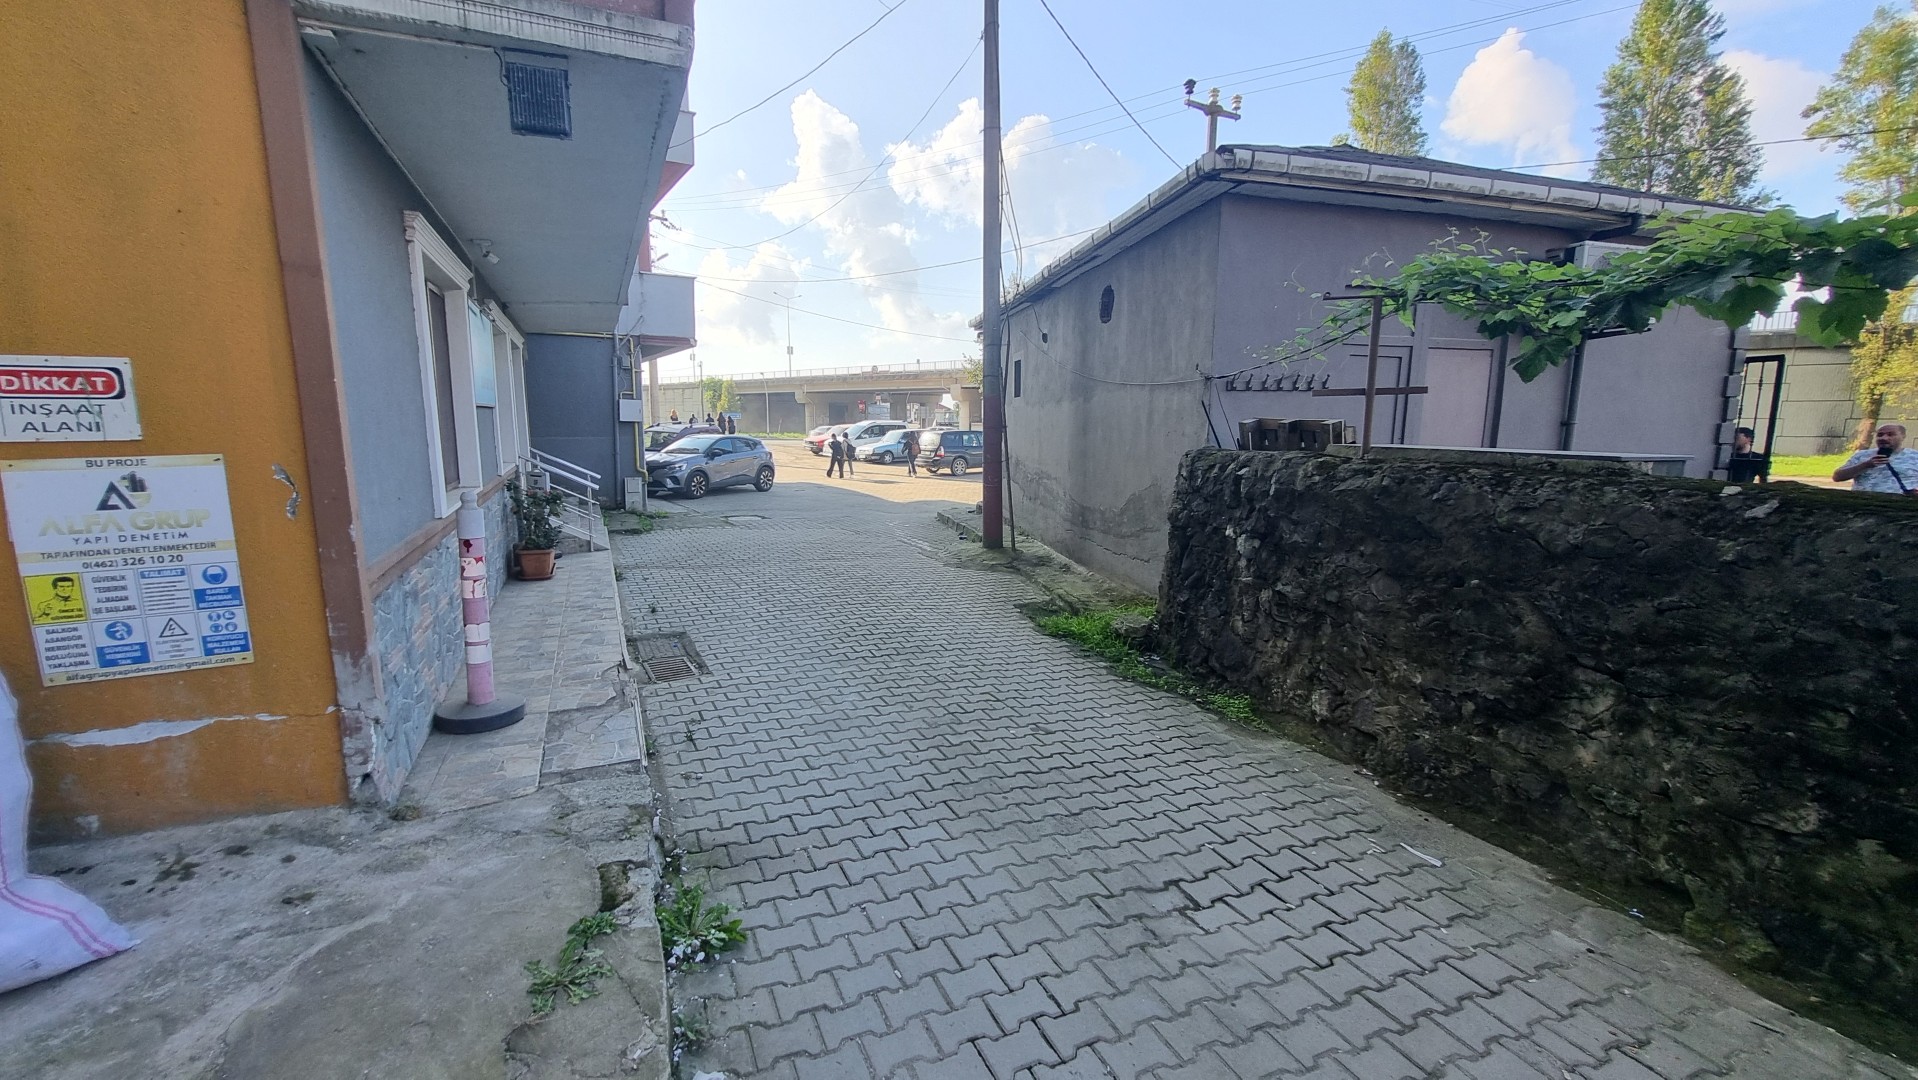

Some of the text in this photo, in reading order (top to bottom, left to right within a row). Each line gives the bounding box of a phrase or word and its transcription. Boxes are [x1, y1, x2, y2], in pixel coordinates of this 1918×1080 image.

[0, 373, 107, 391] DİKKAT
[10, 401, 106, 418] İNŞAAT
[22, 421, 102, 433] ALANI
[85, 458, 147, 468] BU PROJE
[39, 510, 210, 536] ALFA GRUP
[72, 531, 189, 545] YAPI DENETİM
[82, 554, 184, 570] 0(462) 326 10 20
